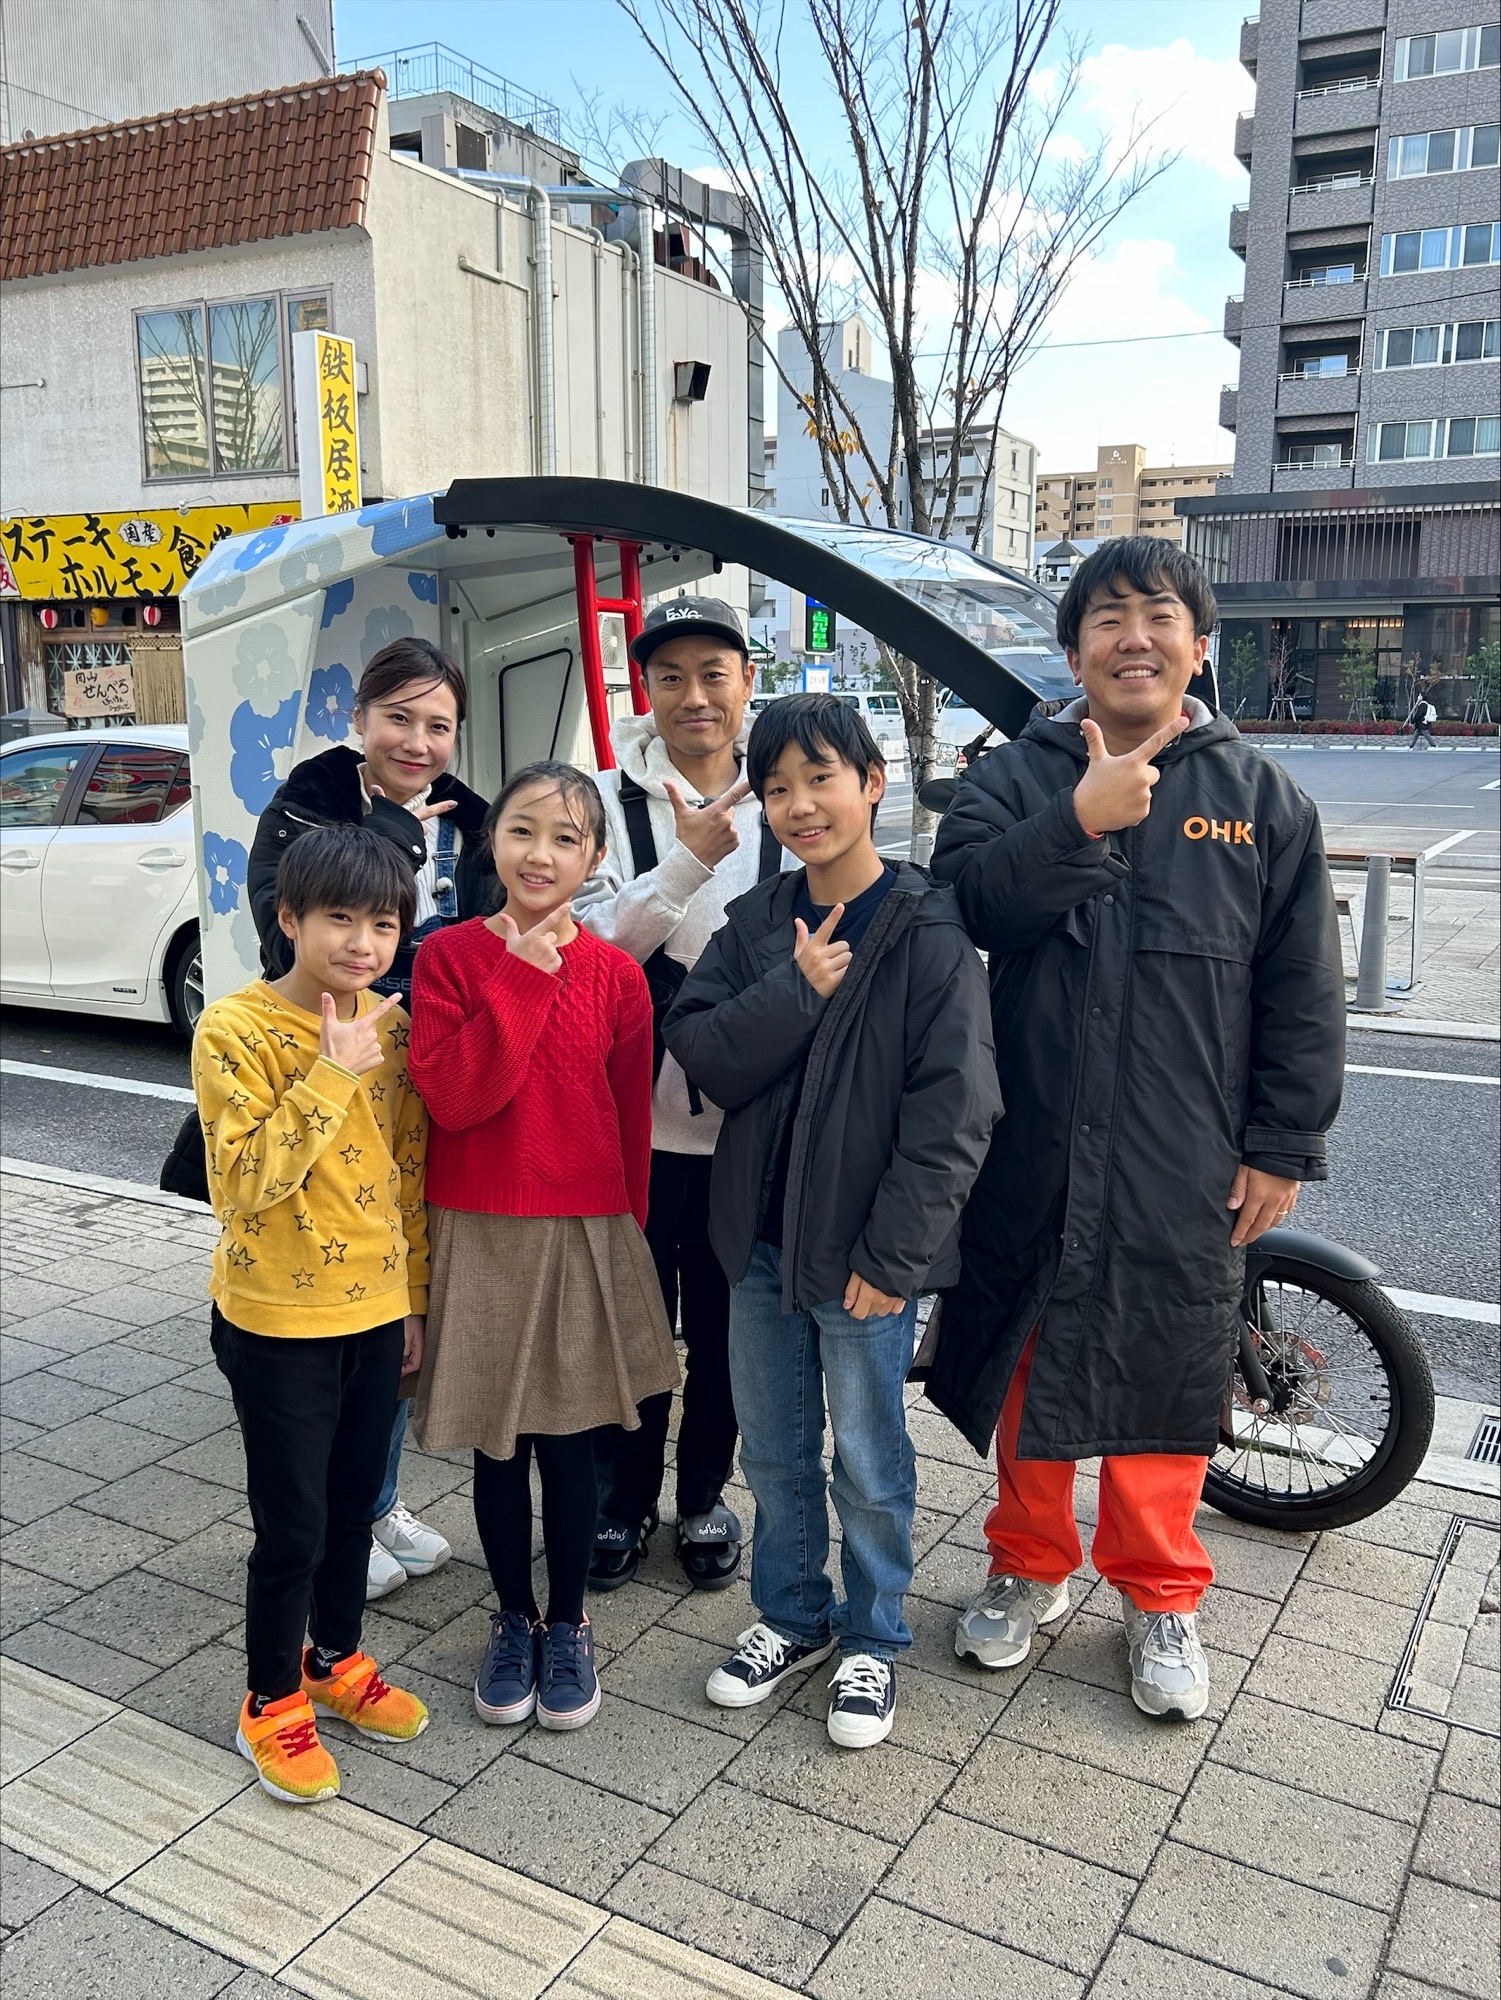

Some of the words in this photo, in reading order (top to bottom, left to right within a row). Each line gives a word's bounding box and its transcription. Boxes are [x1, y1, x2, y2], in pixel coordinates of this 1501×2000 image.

[3, 512, 116, 564] ステーキ
[123, 522, 158, 544] 国産
[58, 553, 175, 598] ホルモン
[75, 671, 98, 684] 岡山
[82, 678, 129, 699] せんべろ
[1183, 816, 1254, 845] OHK
[597, 1528, 627, 1542] adidas
[698, 1523, 728, 1536] adidas
